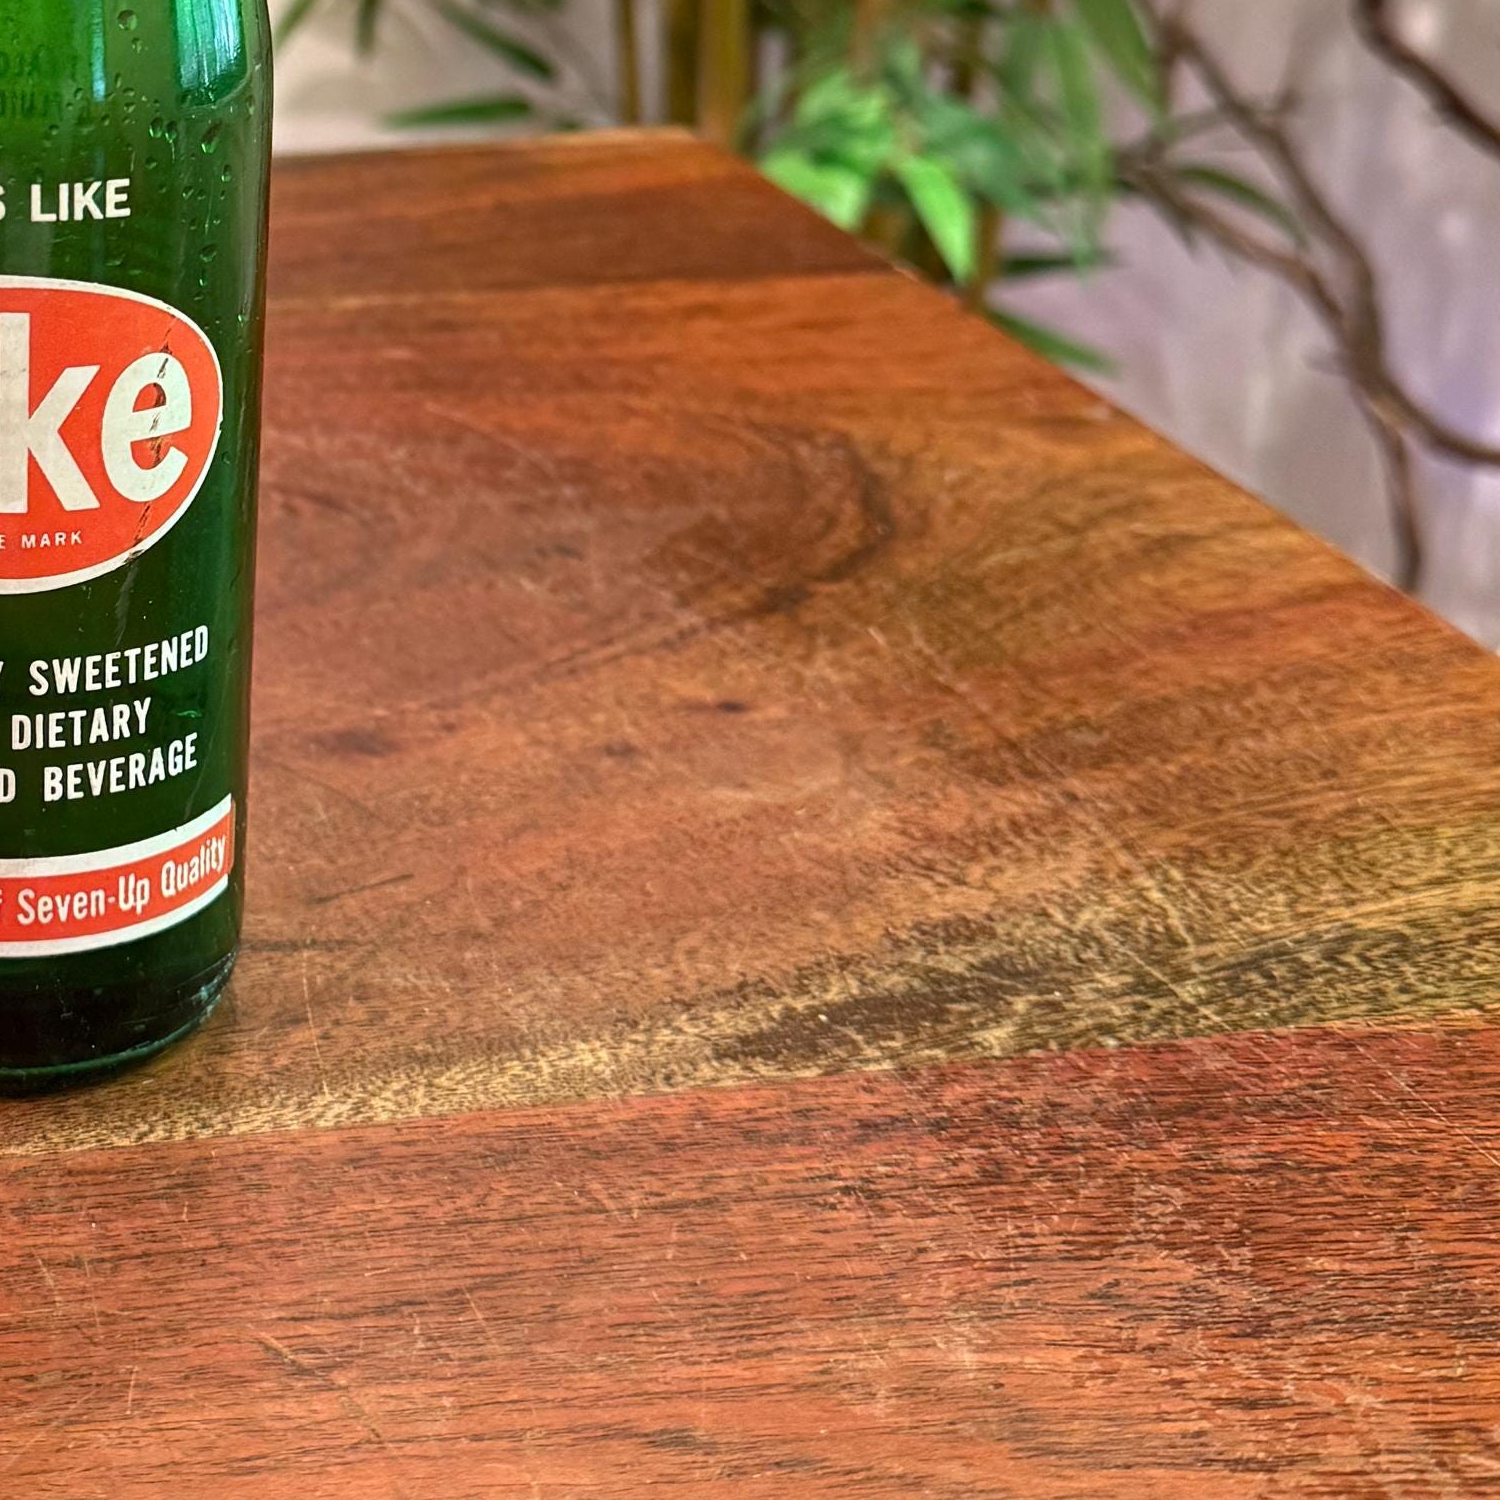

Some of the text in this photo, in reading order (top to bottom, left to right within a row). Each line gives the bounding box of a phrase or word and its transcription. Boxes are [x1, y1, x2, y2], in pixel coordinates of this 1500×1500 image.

[30, 178, 131, 222] LIKE
[21, 530, 83, 550] MARK
[28, 625, 209, 696] SWEETENED
[11, 698, 151, 751] DIETARY
[43, 733, 197, 802] BEVERAGE
[17, 873, 151, 924] Seven-Up
[160, 833, 227, 896] Quality
